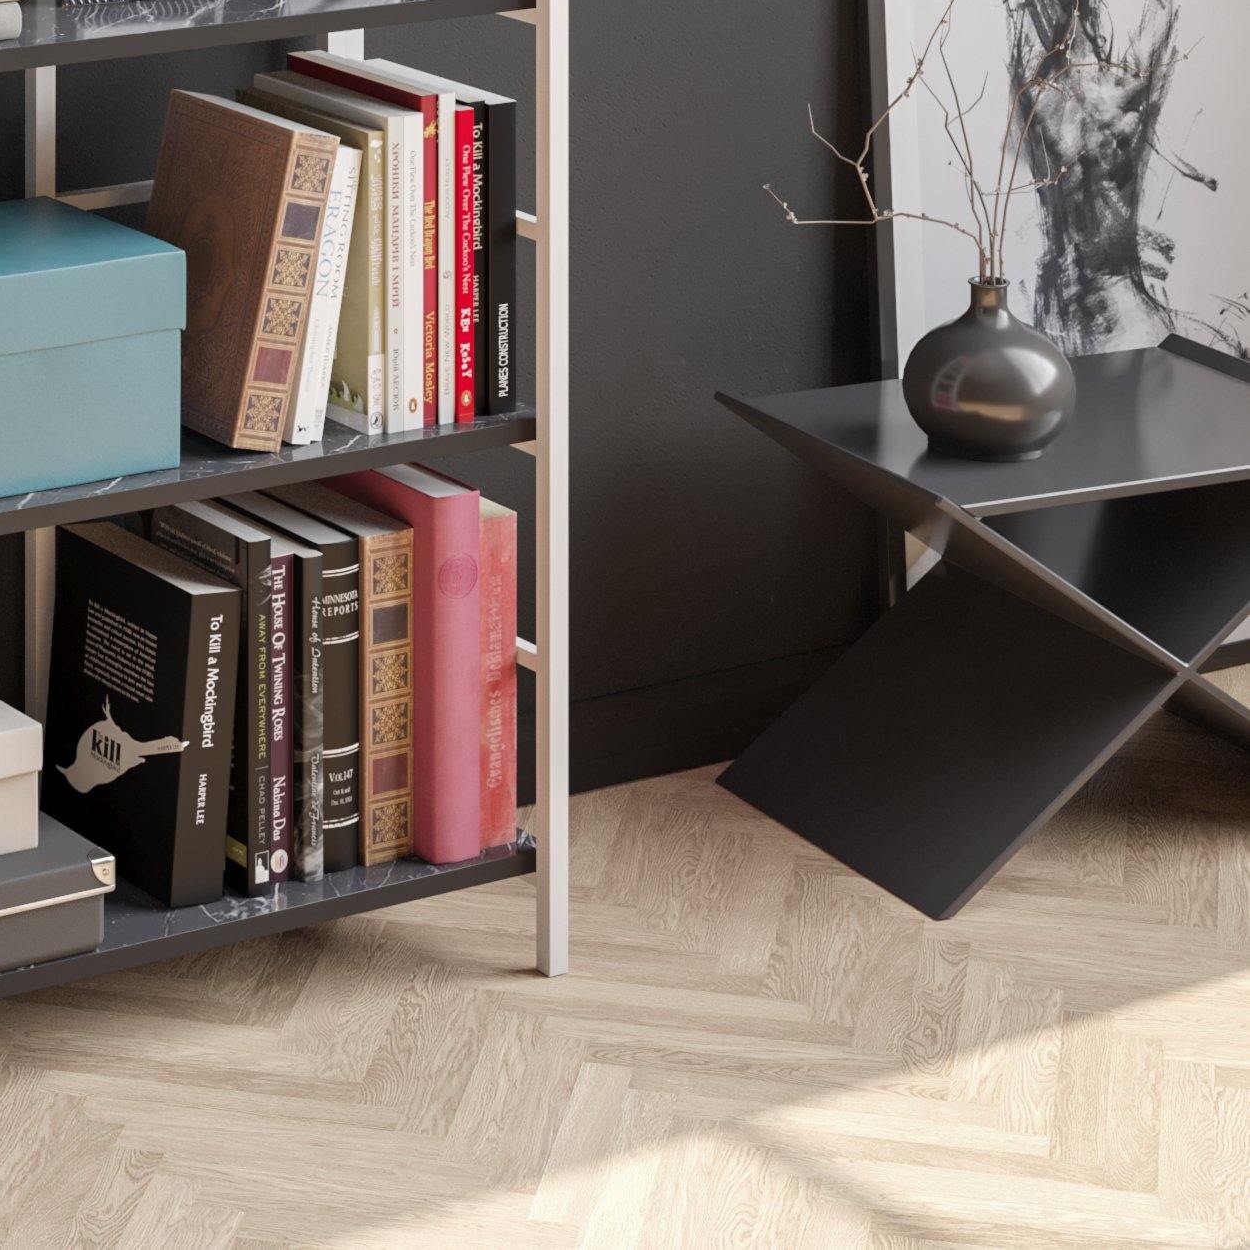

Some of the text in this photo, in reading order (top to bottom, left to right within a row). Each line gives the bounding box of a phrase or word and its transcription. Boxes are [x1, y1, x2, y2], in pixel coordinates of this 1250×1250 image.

[473, 122, 483, 138] To
[473, 141, 483, 159] Kill
[409, 150, 417, 166] One
[424, 200, 436, 214] The
[424, 215, 436, 227] Red
[462, 145, 471, 294] One Flew Over The Cuckoo's Nest
[316, 190, 342, 297] ERAGON
[330, 242, 346, 299] ROOM
[424, 311, 436, 403] Victoria Mosley
[499, 303, 509, 398] PLANES CONSTRUCTION
[309, 596, 321, 694] House of Intention
[200, 614, 224, 749] To Kill a Mockingbird
[258, 614, 266, 759] AWAY FROM EVERYWHERE
[92, 728, 121, 767] kill
[196, 773, 208, 825] HARPER LEE
[258, 775, 266, 845] CHAD PELLEY
[273, 775, 286, 818] Nabina
[273, 818, 286, 841] Das
